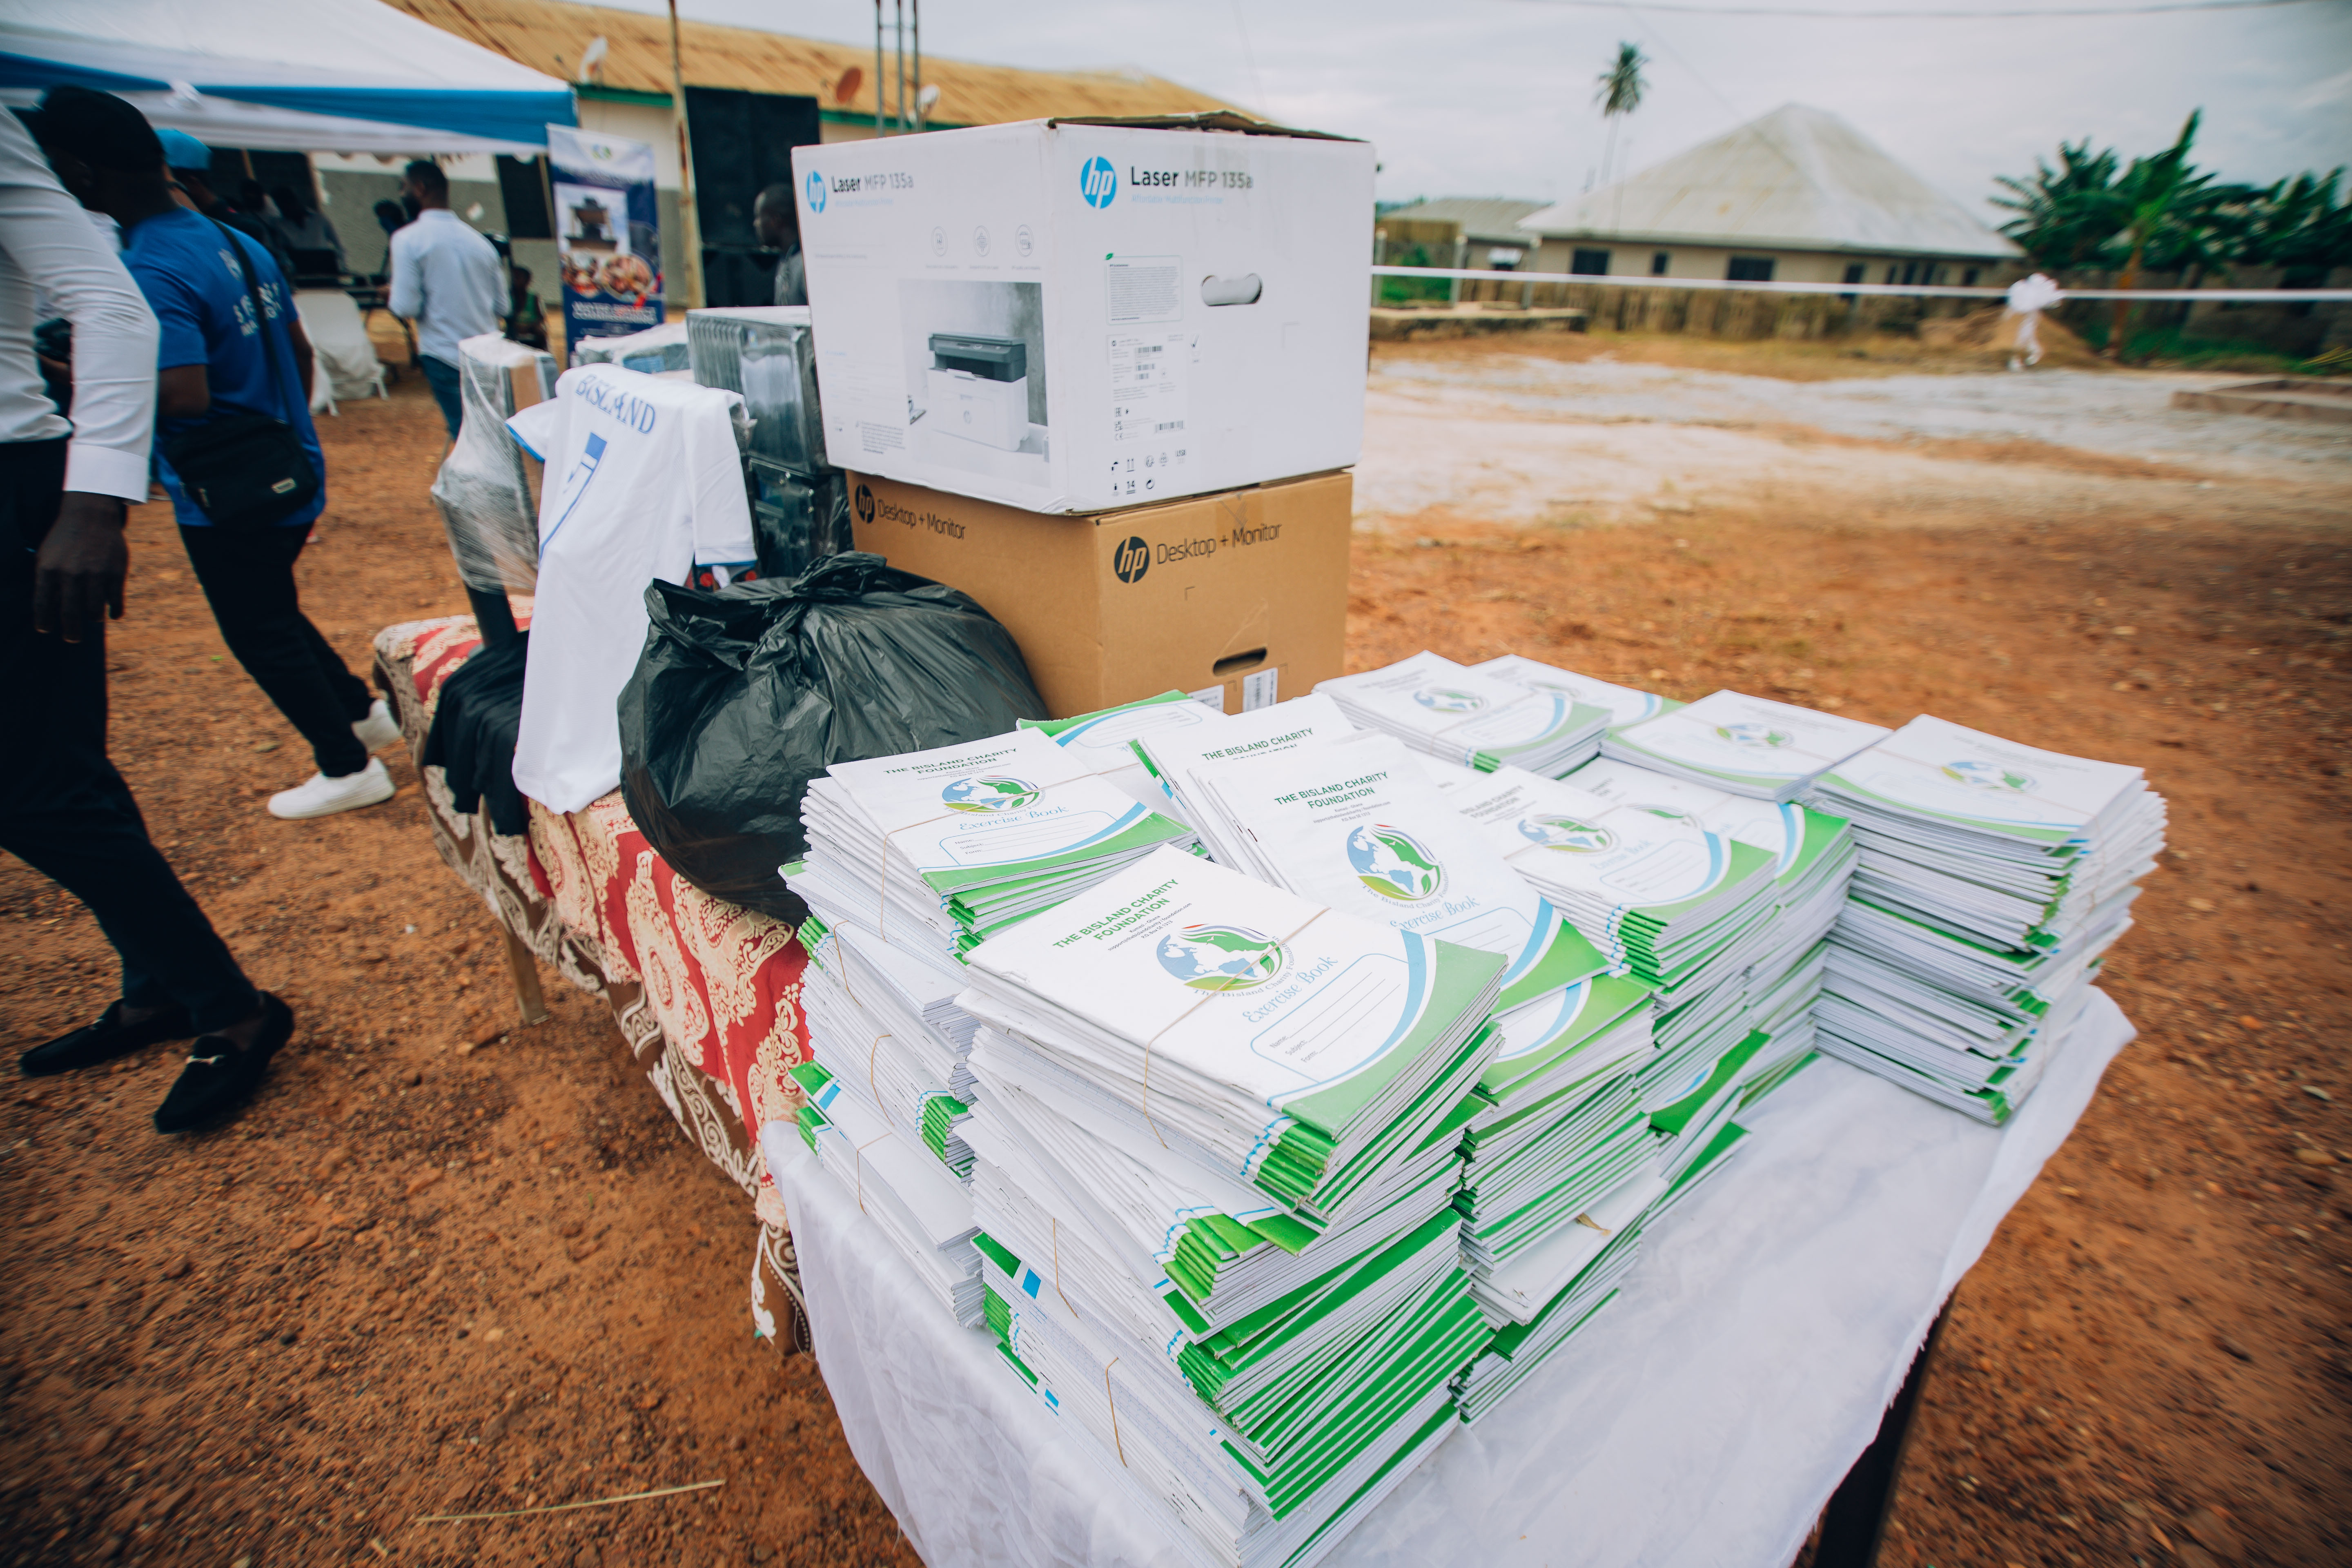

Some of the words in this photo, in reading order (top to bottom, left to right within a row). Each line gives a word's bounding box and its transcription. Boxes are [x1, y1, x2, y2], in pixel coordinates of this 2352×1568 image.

[831, 176, 861, 193] Laser
[864, 175, 886, 190] MFP
[889, 172, 914, 189] 135a
[1085, 156, 1115, 209] hp
[1131, 166, 1179, 186] Laser
[1185, 171, 1217, 187] MFP
[1221, 172, 1253, 189] 135a
[808, 171, 825, 213] hp
[575, 373, 656, 434] BISLAND
[858, 484, 873, 524] hp
[878, 499, 917, 530] Desktop
[927, 512, 966, 539] Monitor
[1156, 538, 1216, 564] Desktop
[1220, 535, 1229, 547] +
[1232, 523, 1282, 548] Monitor
[1118, 537, 1147, 584] hp
[1202, 750, 1225, 760] THE
[1225, 741, 1269, 755] BISLAND
[1270, 728, 1313, 745] CHARITY
[911, 759, 964, 770] BISLAND
[967, 748, 1017, 760] CHARITY
[917, 758, 997, 774] FOUNDATION
[1274, 794, 1298, 805] THE
[1298, 784, 1343, 798] BISLAND
[1345, 771, 1388, 788] CHARITY
[1307, 787, 1375, 808] FOUNDATION
[960, 815, 1022, 830] Exercise
[1026, 806, 1069, 818] Book
[1362, 883, 1379, 898] The
[1381, 896, 1414, 909] Bisland
[1416, 897, 1441, 909] Charity
[1442, 895, 1480, 916] Book
[1052, 933, 1082, 947] THE
[1079, 907, 1132, 935] BISLAND
[1131, 879, 1179, 908] CHARITY
[1093, 898, 1171, 940] FOUNDATION
[1129, 924, 1145, 933] Kumasi
[1147, 915, 1160, 924] Ghana
[1162, 902, 1192, 921] foundation.com
[1193, 988, 1219, 997] The
[1223, 987, 1264, 997] Bisland
[1265, 971, 1292, 989] Charity
[1243, 984, 1303, 1022] Exercise
[1296, 956, 1338, 984] Book
[1270, 1036, 1289, 1048] Name:
[1285, 1040, 1308, 1056] Subject:
[1301, 1050, 1318, 1063] Form:
